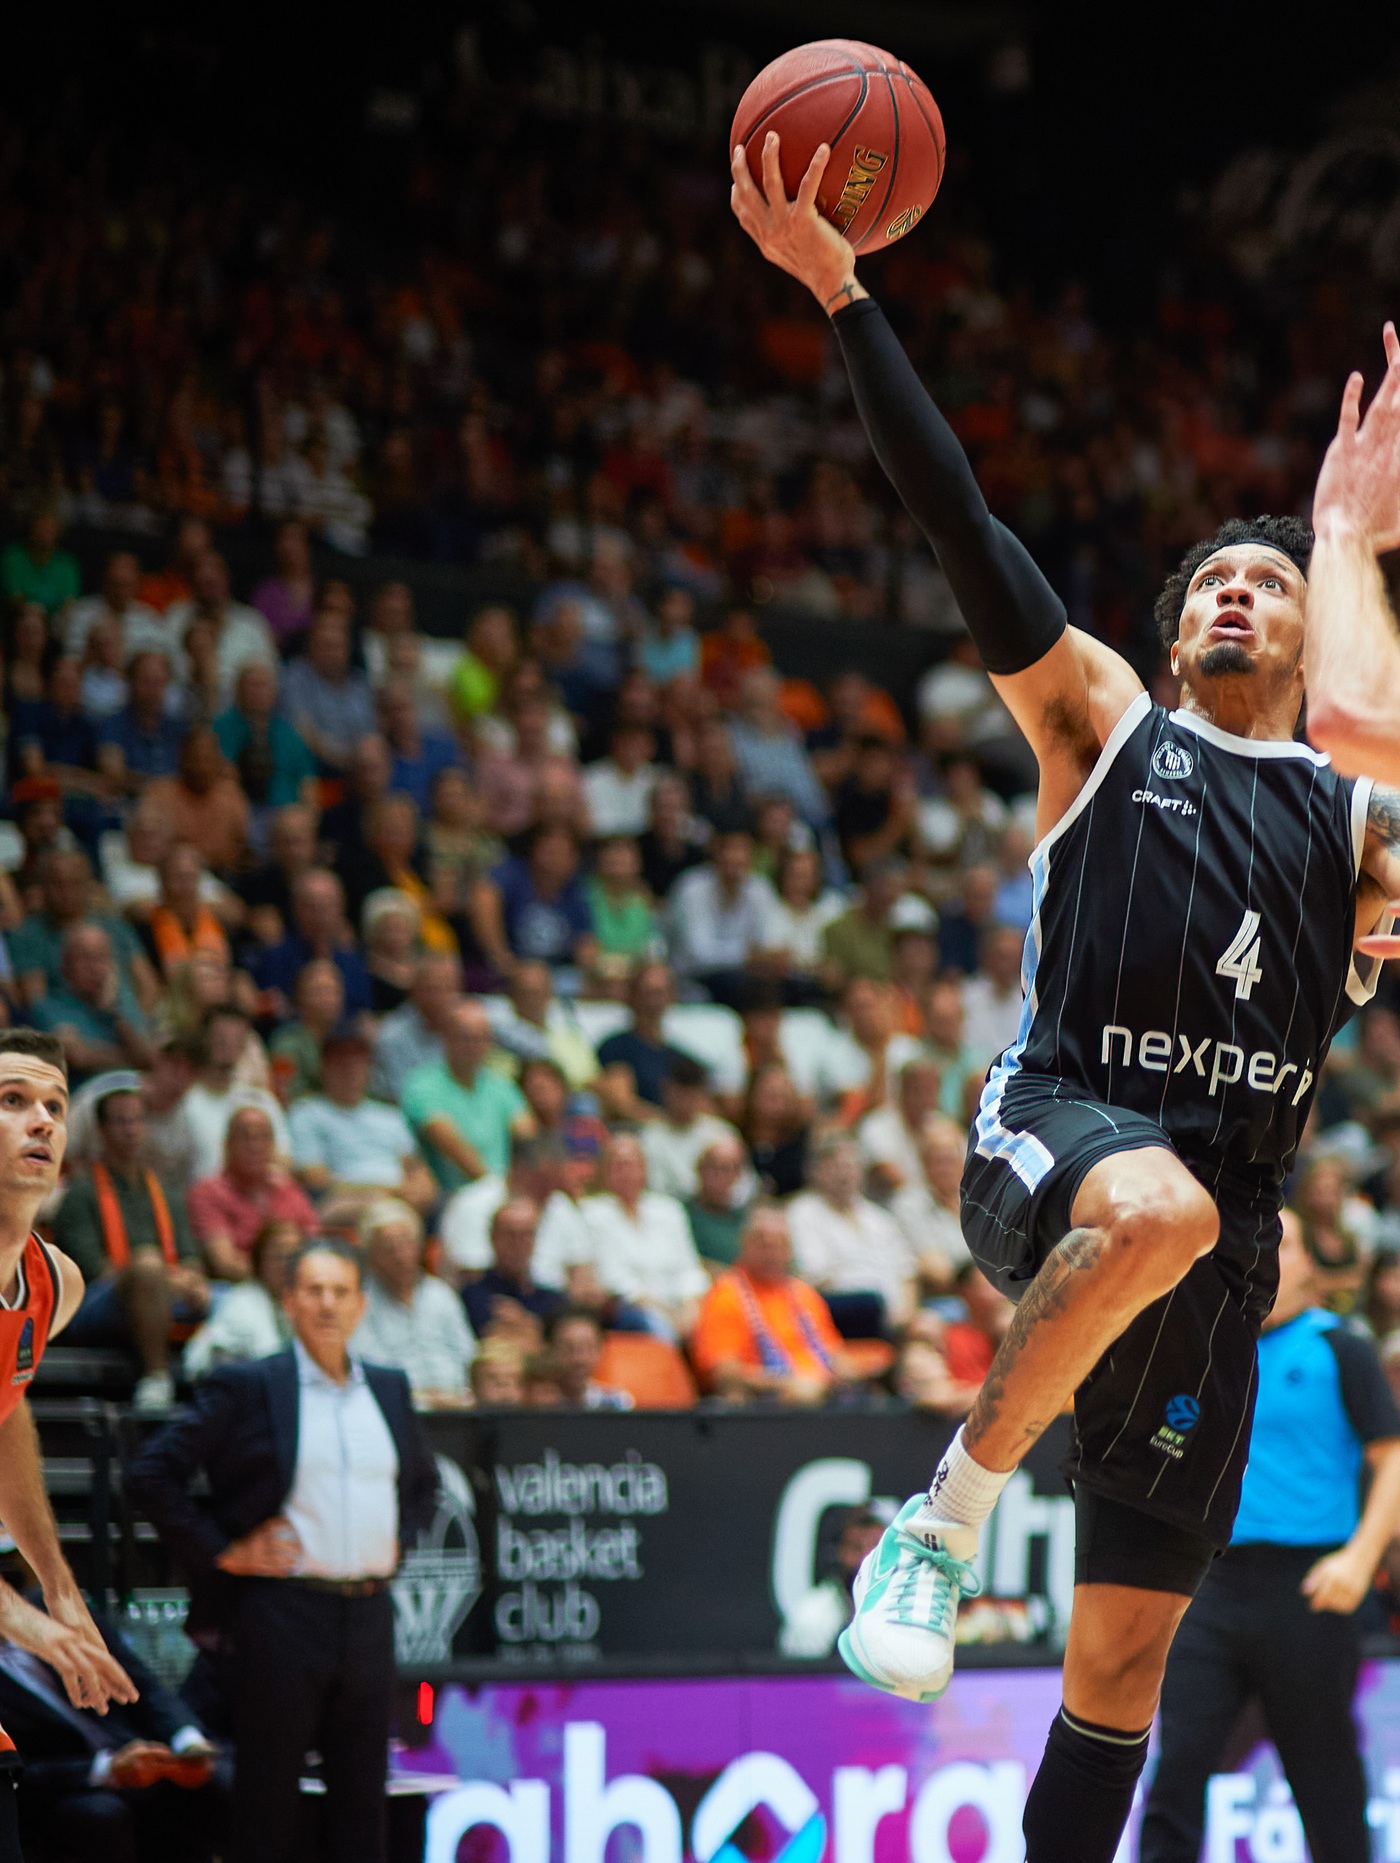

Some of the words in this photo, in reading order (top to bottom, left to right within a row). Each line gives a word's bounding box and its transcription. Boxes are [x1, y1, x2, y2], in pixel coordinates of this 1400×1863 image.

[1131, 789, 1183, 812] CRAFT
[1215, 909, 1263, 1001] 4
[494, 1447, 668, 1516] valencia
[498, 1516, 645, 1580] basket
[495, 1579, 600, 1642] club
